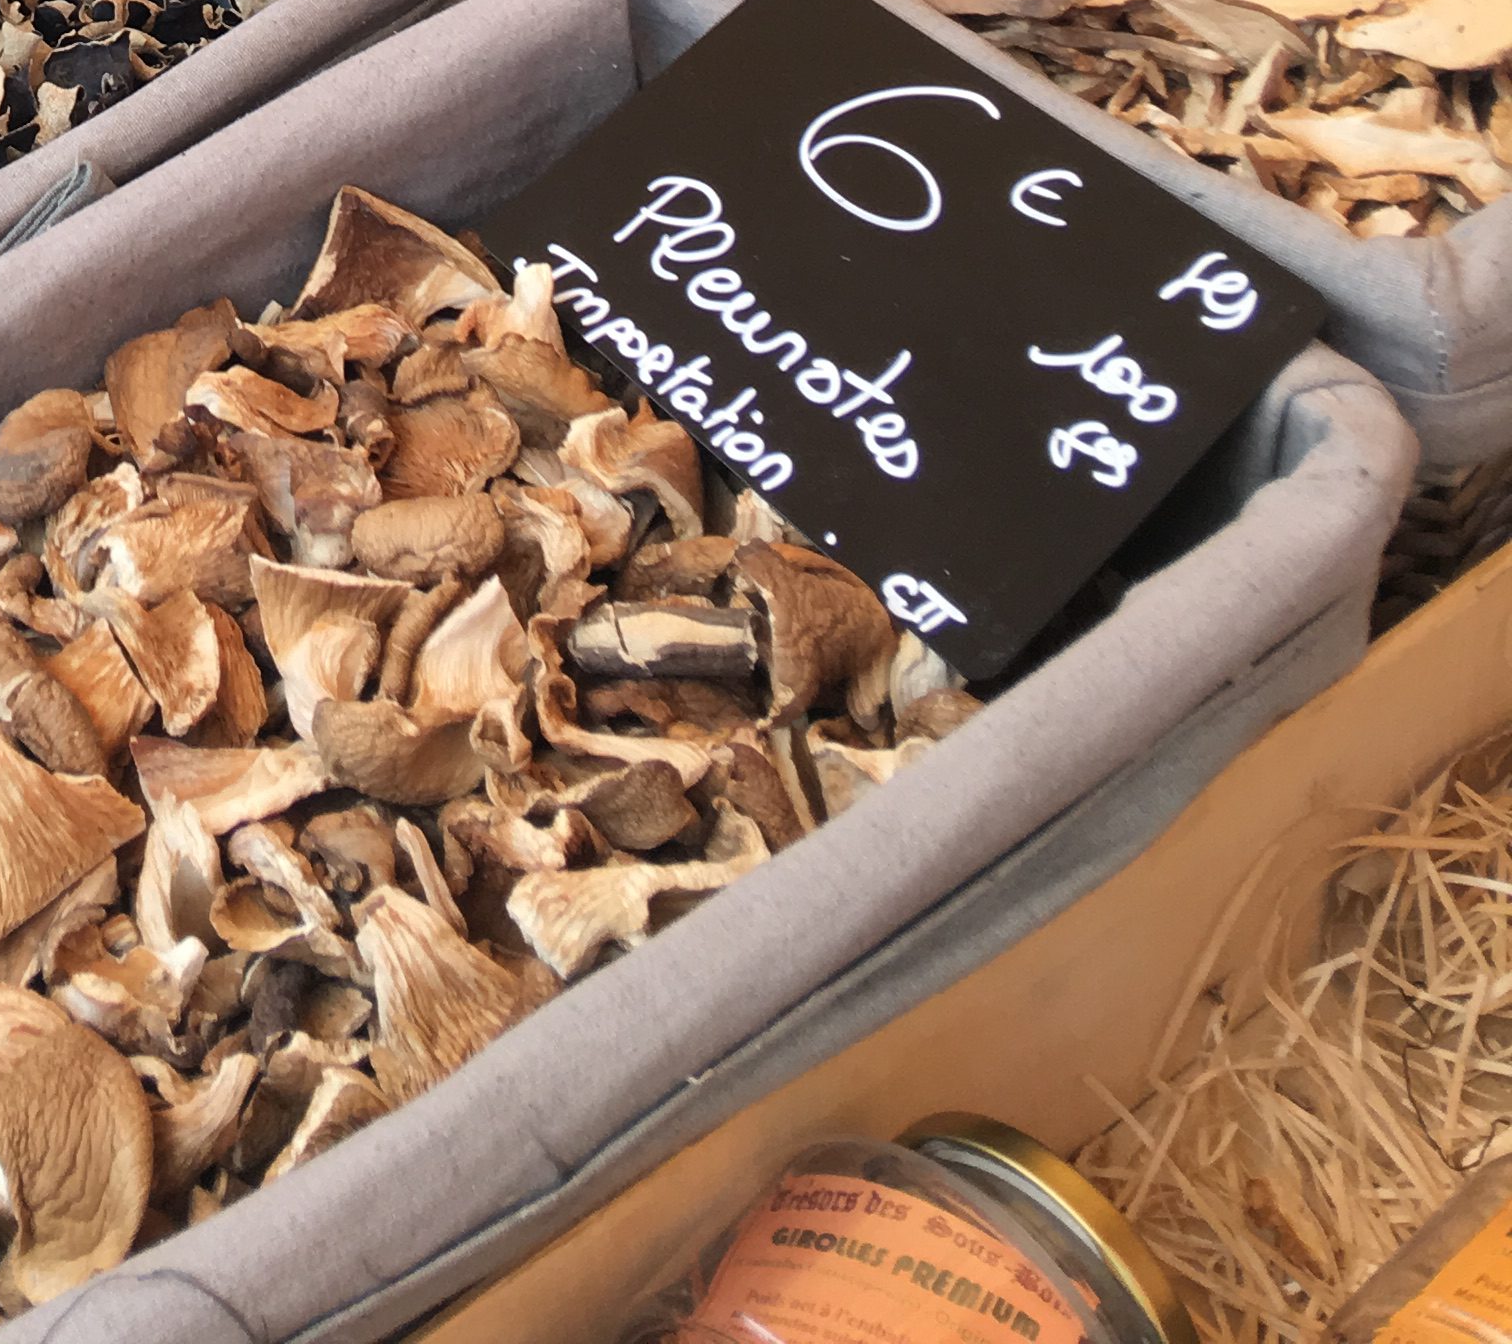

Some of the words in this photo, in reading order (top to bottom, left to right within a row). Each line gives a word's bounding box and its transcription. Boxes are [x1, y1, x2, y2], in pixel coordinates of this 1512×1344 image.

[799, 84, 1001, 232] 6
[1029, 333, 1179, 423] 100
[772, 1226, 889, 1268] GIROLLES
[890, 1255, 1041, 1343] PREMIUM
